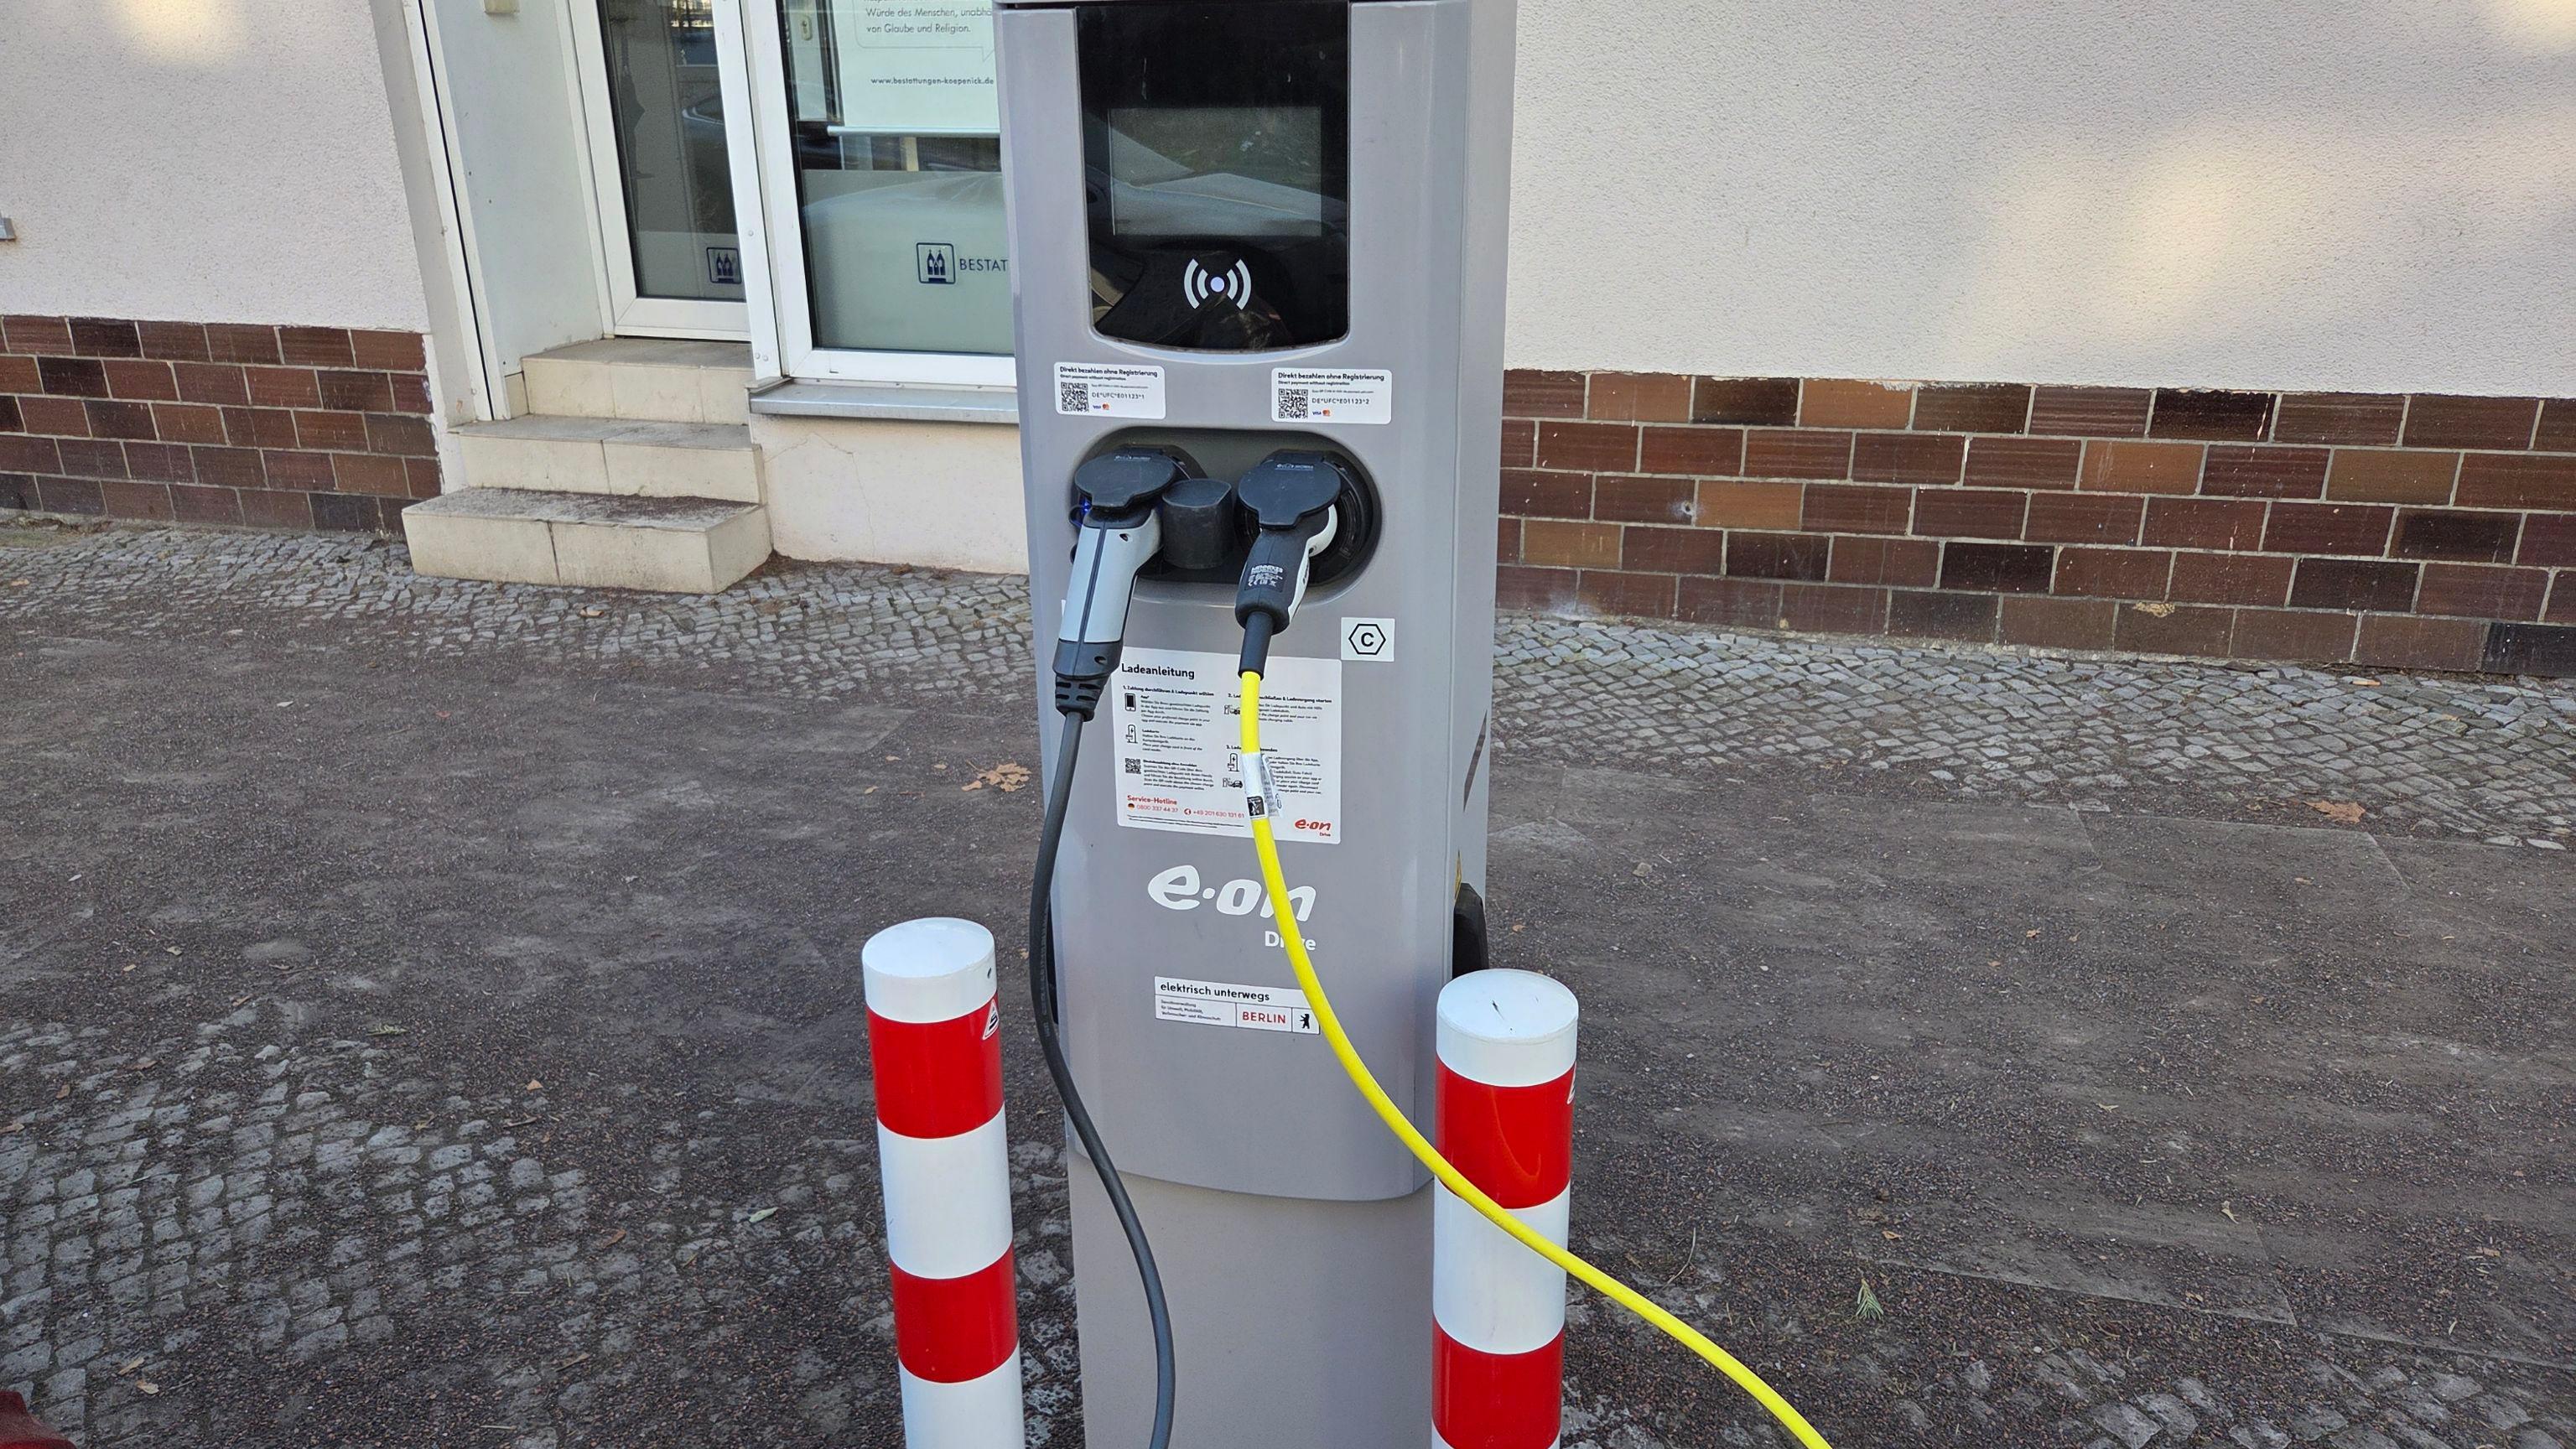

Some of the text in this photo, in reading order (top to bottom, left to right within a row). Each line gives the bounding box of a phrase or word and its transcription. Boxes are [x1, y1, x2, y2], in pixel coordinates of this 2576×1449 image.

[865, 7, 895, 17] Würde
[897, 8, 911, 17] des
[914, 8, 958, 18] Menschen,
[884, 23, 915, 34] Glaube
[917, 23, 932, 34] und
[935, 23, 971, 35] Religion.
[1119, 369, 1158, 378] Registrierung
[1361, 632, 1374, 647] C
[1121, 662, 1195, 680] Ladeanleitung
[1127, 795, 1177, 805] Service-Hotline
[1161, 982, 1270, 1002] elektrisch unterwegs
[1242, 1011, 1286, 1024] BERLIN
